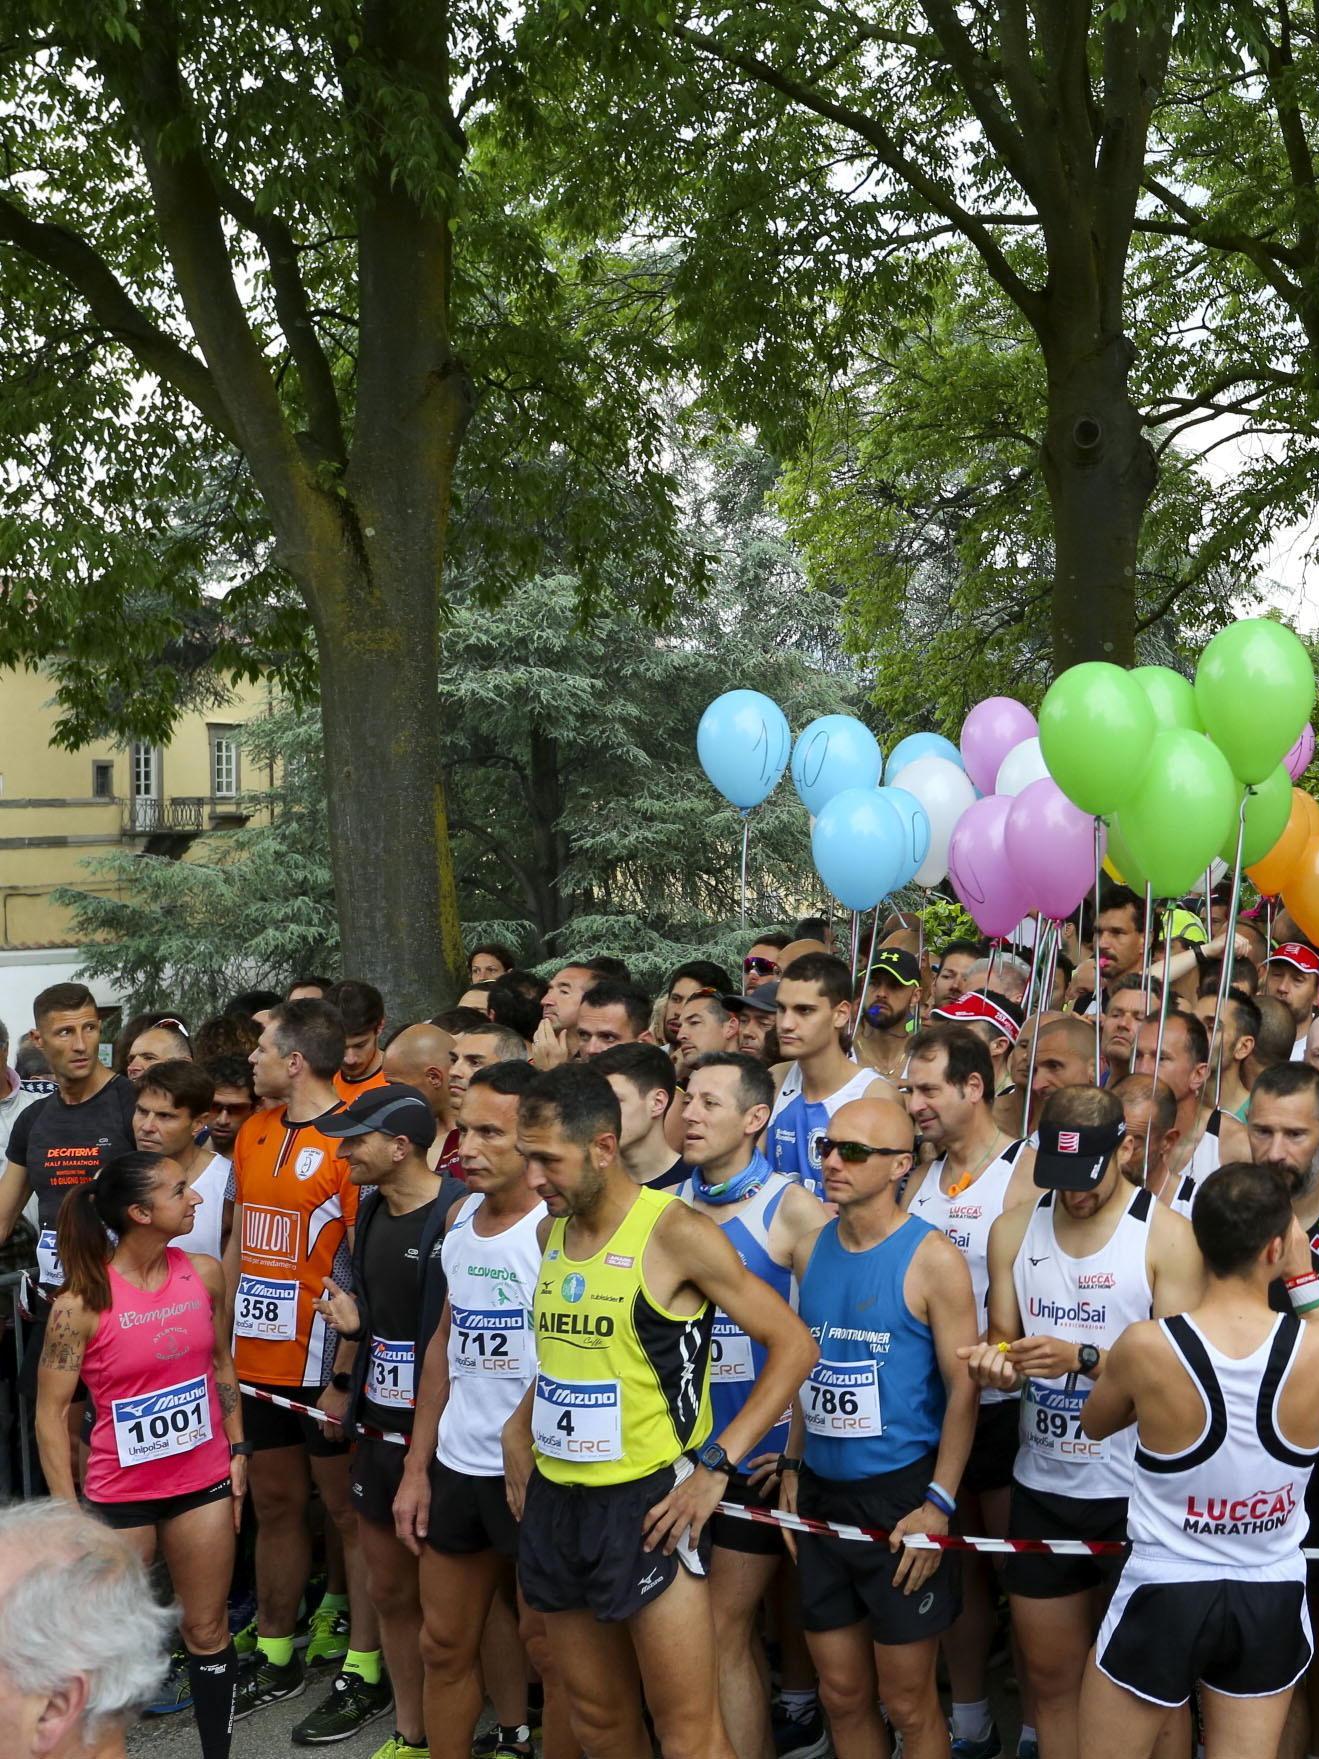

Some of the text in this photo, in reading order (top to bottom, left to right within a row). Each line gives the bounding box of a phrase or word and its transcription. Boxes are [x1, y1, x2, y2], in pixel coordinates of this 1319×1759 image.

[949, 1206, 979, 1215] LUCCA
[468, 1265, 521, 1282] ecoverde
[1078, 1274, 1112, 1284] LUCCA
[240, 1297, 279, 1322] 358
[1029, 1296, 1106, 1326] UnipolSai
[257, 1322, 288, 1335] CRC
[539, 1311, 614, 1337] AIELLO
[458, 1330, 509, 1356] 712
[869, 1343, 890, 1353] ITALY
[482, 1358, 520, 1370] CRC
[380, 1387, 412, 1400] CRC
[810, 1385, 859, 1416] 786
[128, 1402, 204, 1444] 1001
[556, 1409, 575, 1437] 4
[831, 1416, 872, 1430] CRC
[1035, 1408, 1083, 1440] 897
[175, 1425, 207, 1446] CRC
[128, 1439, 170, 1456] UnipolSai
[567, 1439, 611, 1453] CRC
[1060, 1440, 1102, 1455] CRC
[1185, 1494, 1286, 1523] LUCCA
[1183, 1512, 1288, 1535] MARATHON
